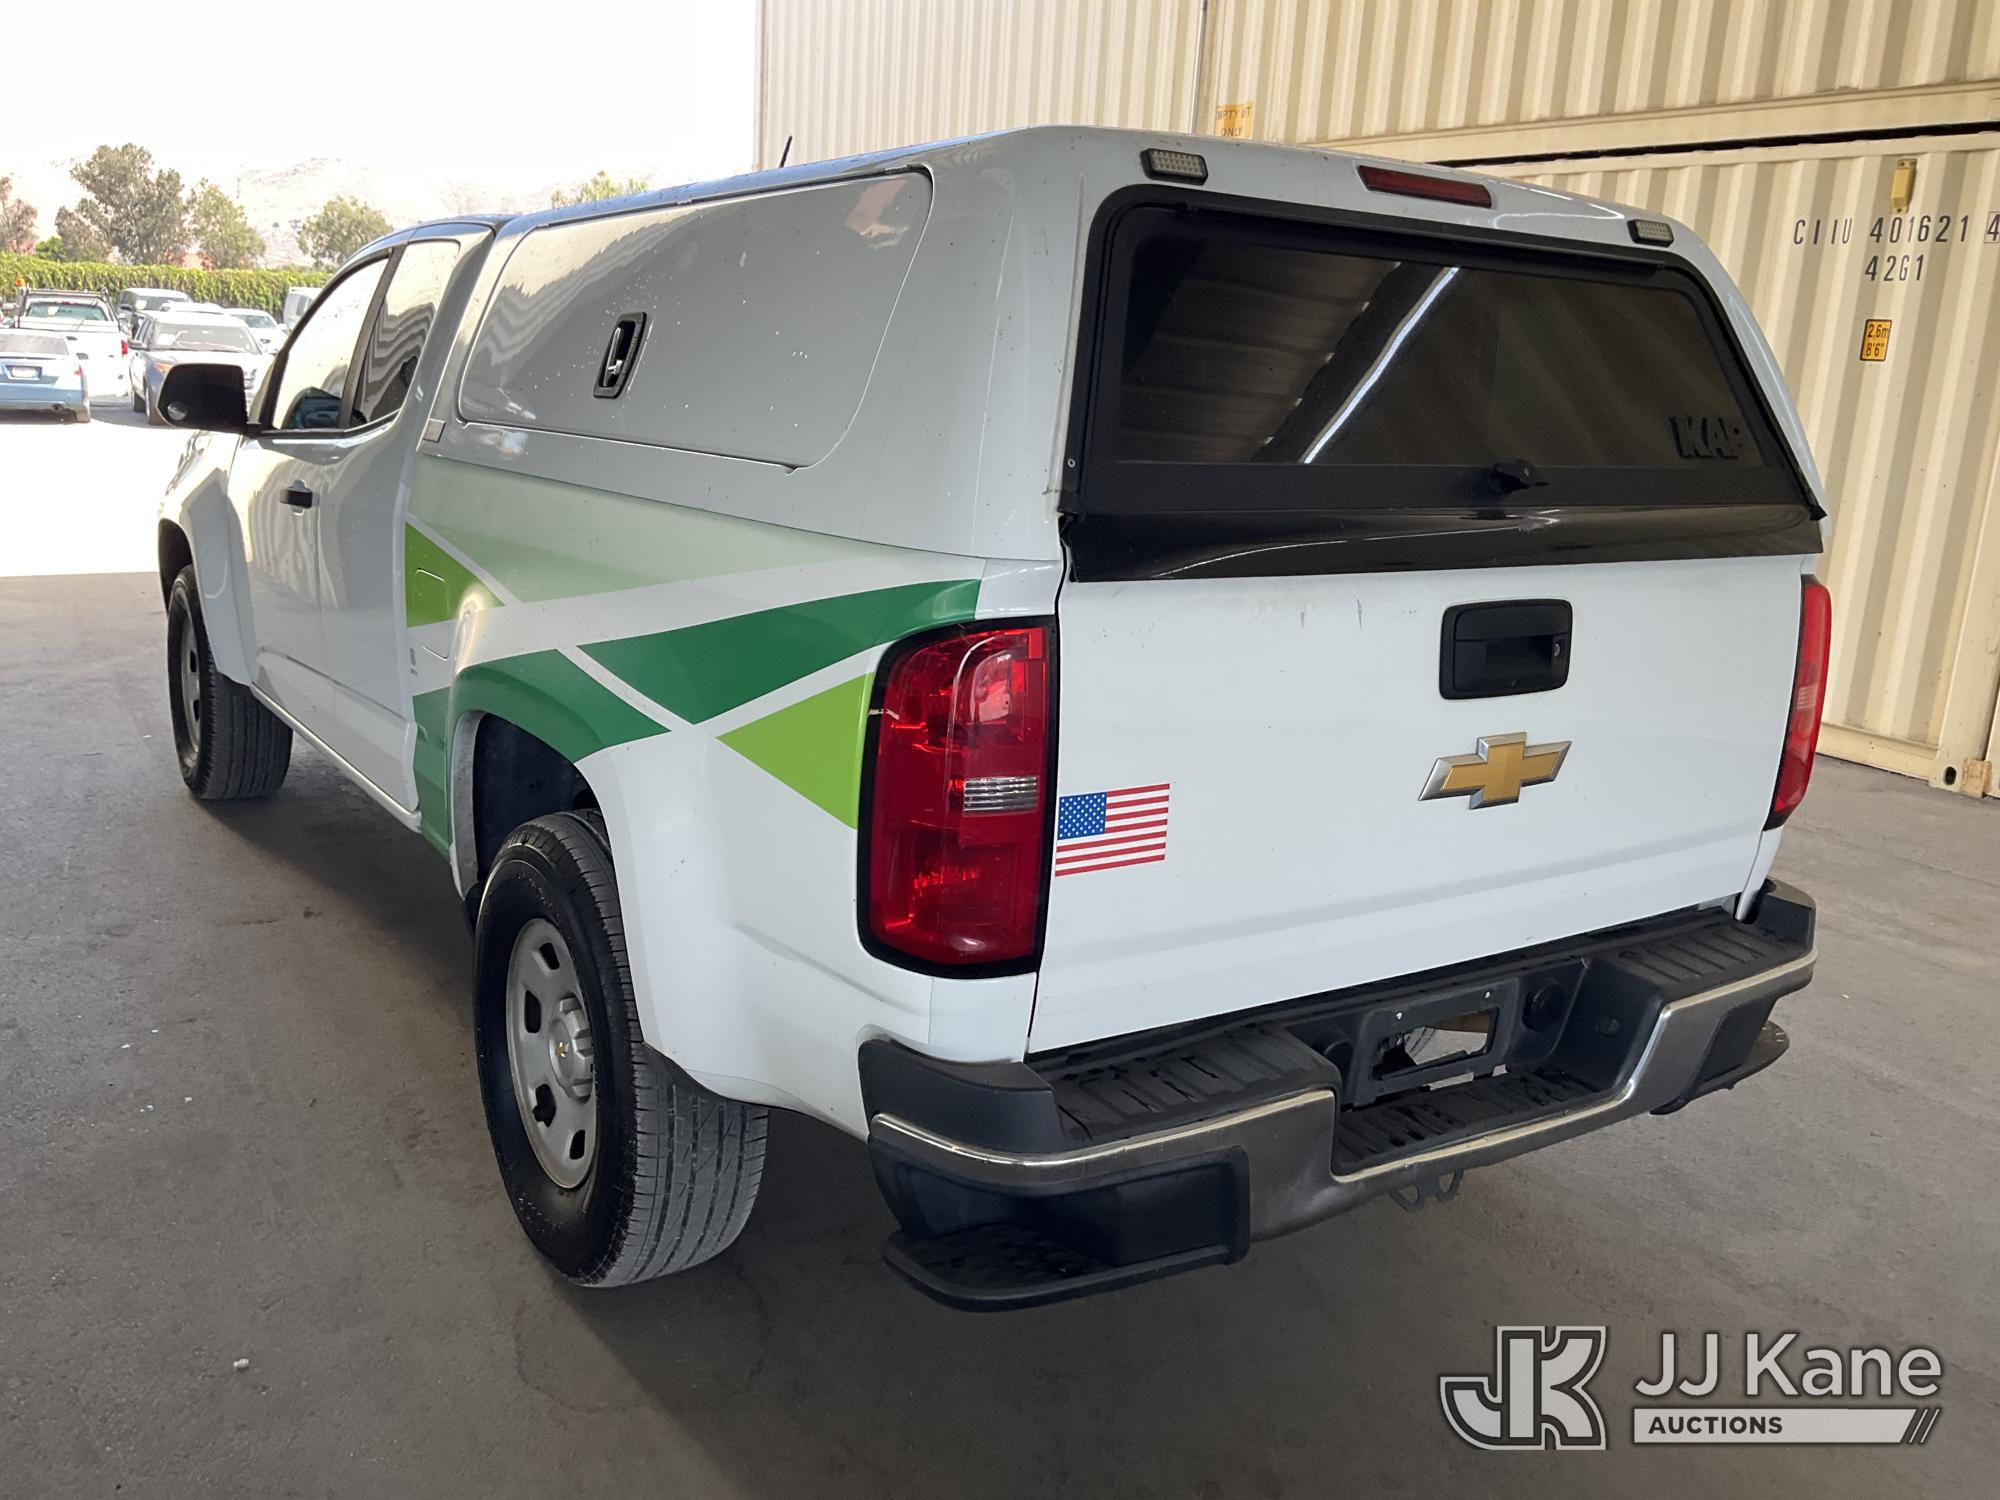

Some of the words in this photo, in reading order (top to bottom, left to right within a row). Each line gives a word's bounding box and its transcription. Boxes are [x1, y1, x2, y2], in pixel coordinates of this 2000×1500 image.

[1793, 218, 1853, 245] CIIU
[1869, 214, 1969, 244] 401621
[1864, 255, 1924, 281] 42G1
